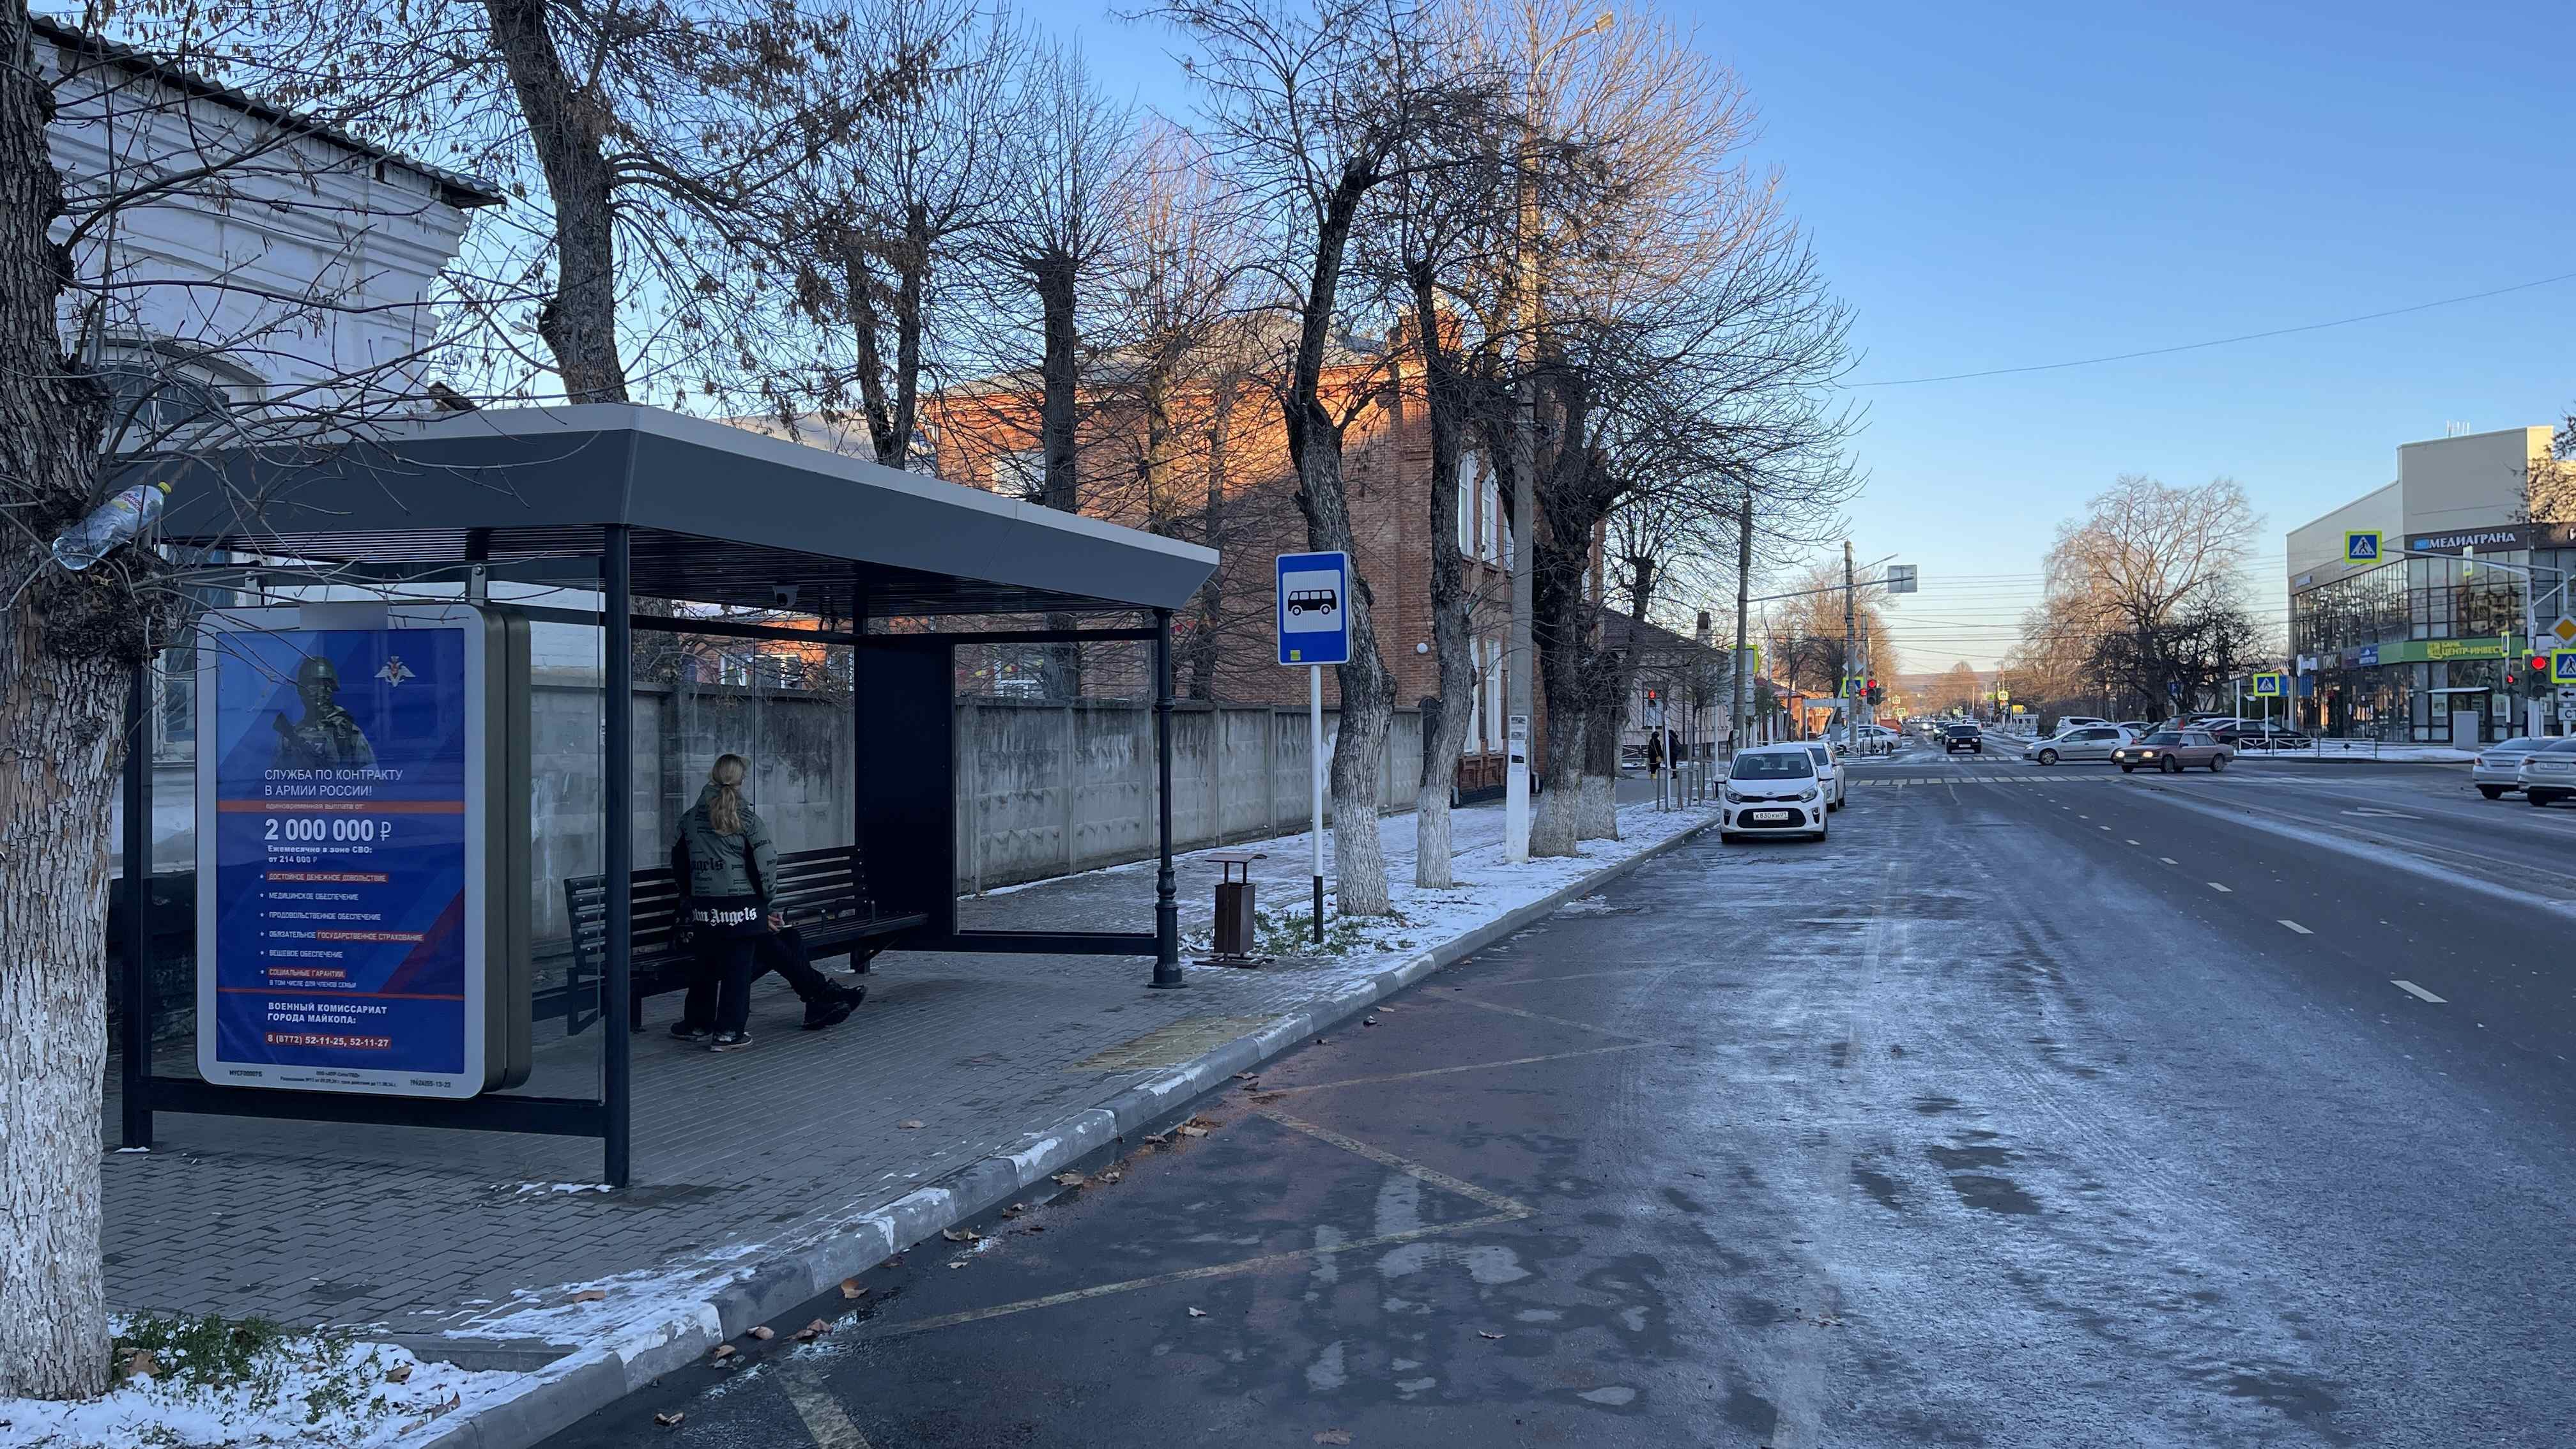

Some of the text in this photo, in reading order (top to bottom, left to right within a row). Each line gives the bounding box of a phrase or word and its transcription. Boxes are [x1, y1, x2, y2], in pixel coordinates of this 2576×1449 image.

[2428, 532, 2516, 549] МЕДИАГРАНД
[264, 769, 403, 781] СЛУЖБА ПО КОНТРАКТУ
[264, 785, 372, 796] В АРМИИ РОССИИ!
[264, 818, 279, 841] 2
[285, 818, 326, 841] 000
[332, 818, 374, 841] 000
[267, 845, 320, 854] Ежемесячно
[268, 872, 387, 882] ДОСТОЙНОЕ ДЕНЕЖНОЕ ДОВОЛЬСТВИЕ
[315, 893, 359, 901] ОБЕСПЕЧЕНИЕ
[268, 912, 381, 921] ПРОДОВОЛЬСТВЕННОЕ ОБЕСПЕЧЕНИЕ
[710, 906, 758, 927] Angels
[269, 930, 424, 941] ОБЯЗАТЕЛЬНОЕ ГОСУДАРСТВЕННОЕ СТРАХОВАНИЕ
[300, 950, 343, 958] ОБЕСПЕЧЕНИЕ
[269, 969, 310, 977] СОЦИАЛЬНЫЕ
[268, 1002, 387, 1015] ВОЕННЫЙ КОМИССАРИАТ
[267, 1013, 356, 1024] ГОРОДА МАЙКОПА:
[275, 1034, 302, 1045] (8772)
[305, 1036, 347, 1046] 52-11-25,
[349, 1038, 389, 1046] 52-11-27
